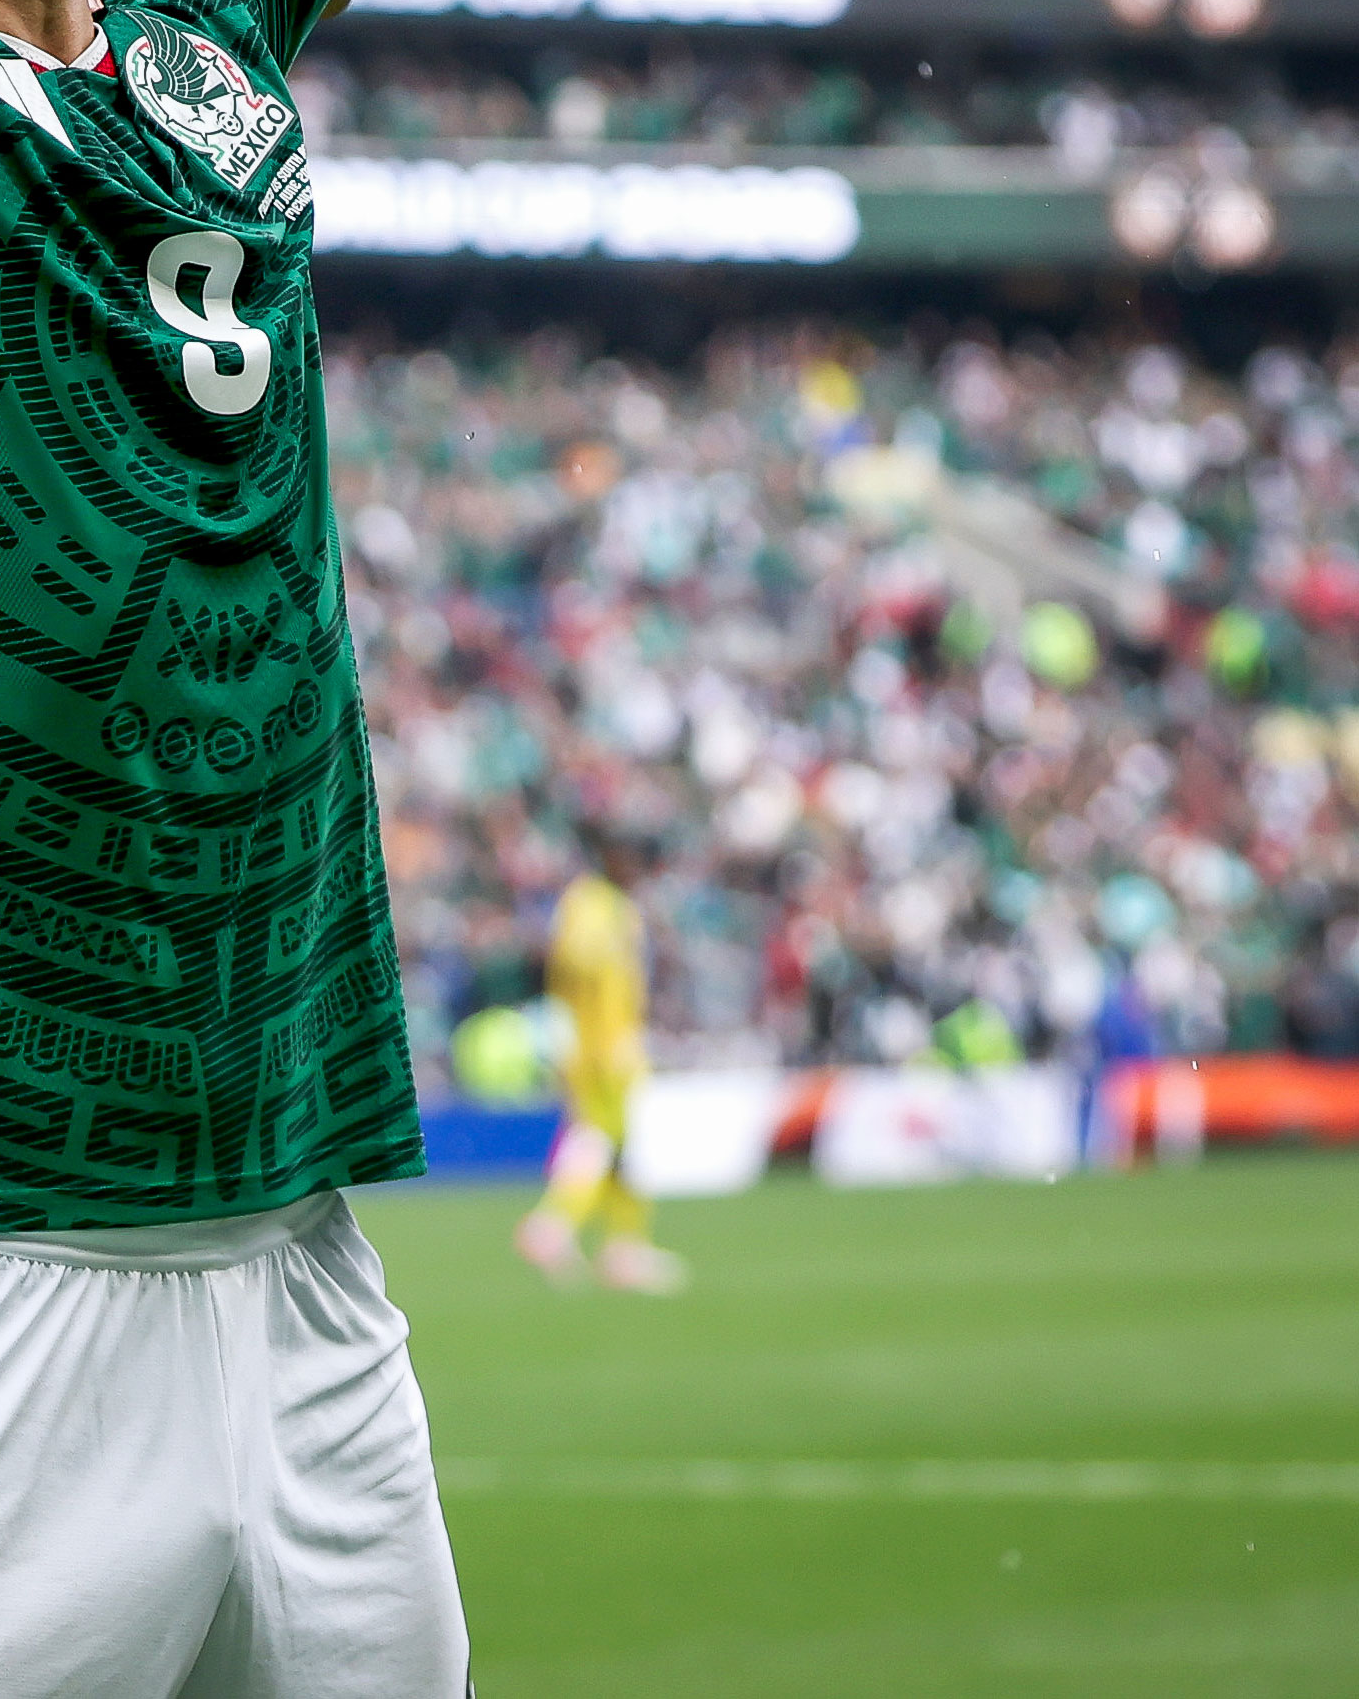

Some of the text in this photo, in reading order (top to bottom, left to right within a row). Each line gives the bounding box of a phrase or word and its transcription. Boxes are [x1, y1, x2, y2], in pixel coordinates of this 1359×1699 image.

[220, 103, 286, 183] MÉXICO
[277, 153, 304, 182] SOUTH
[147, 231, 272, 415] 9
